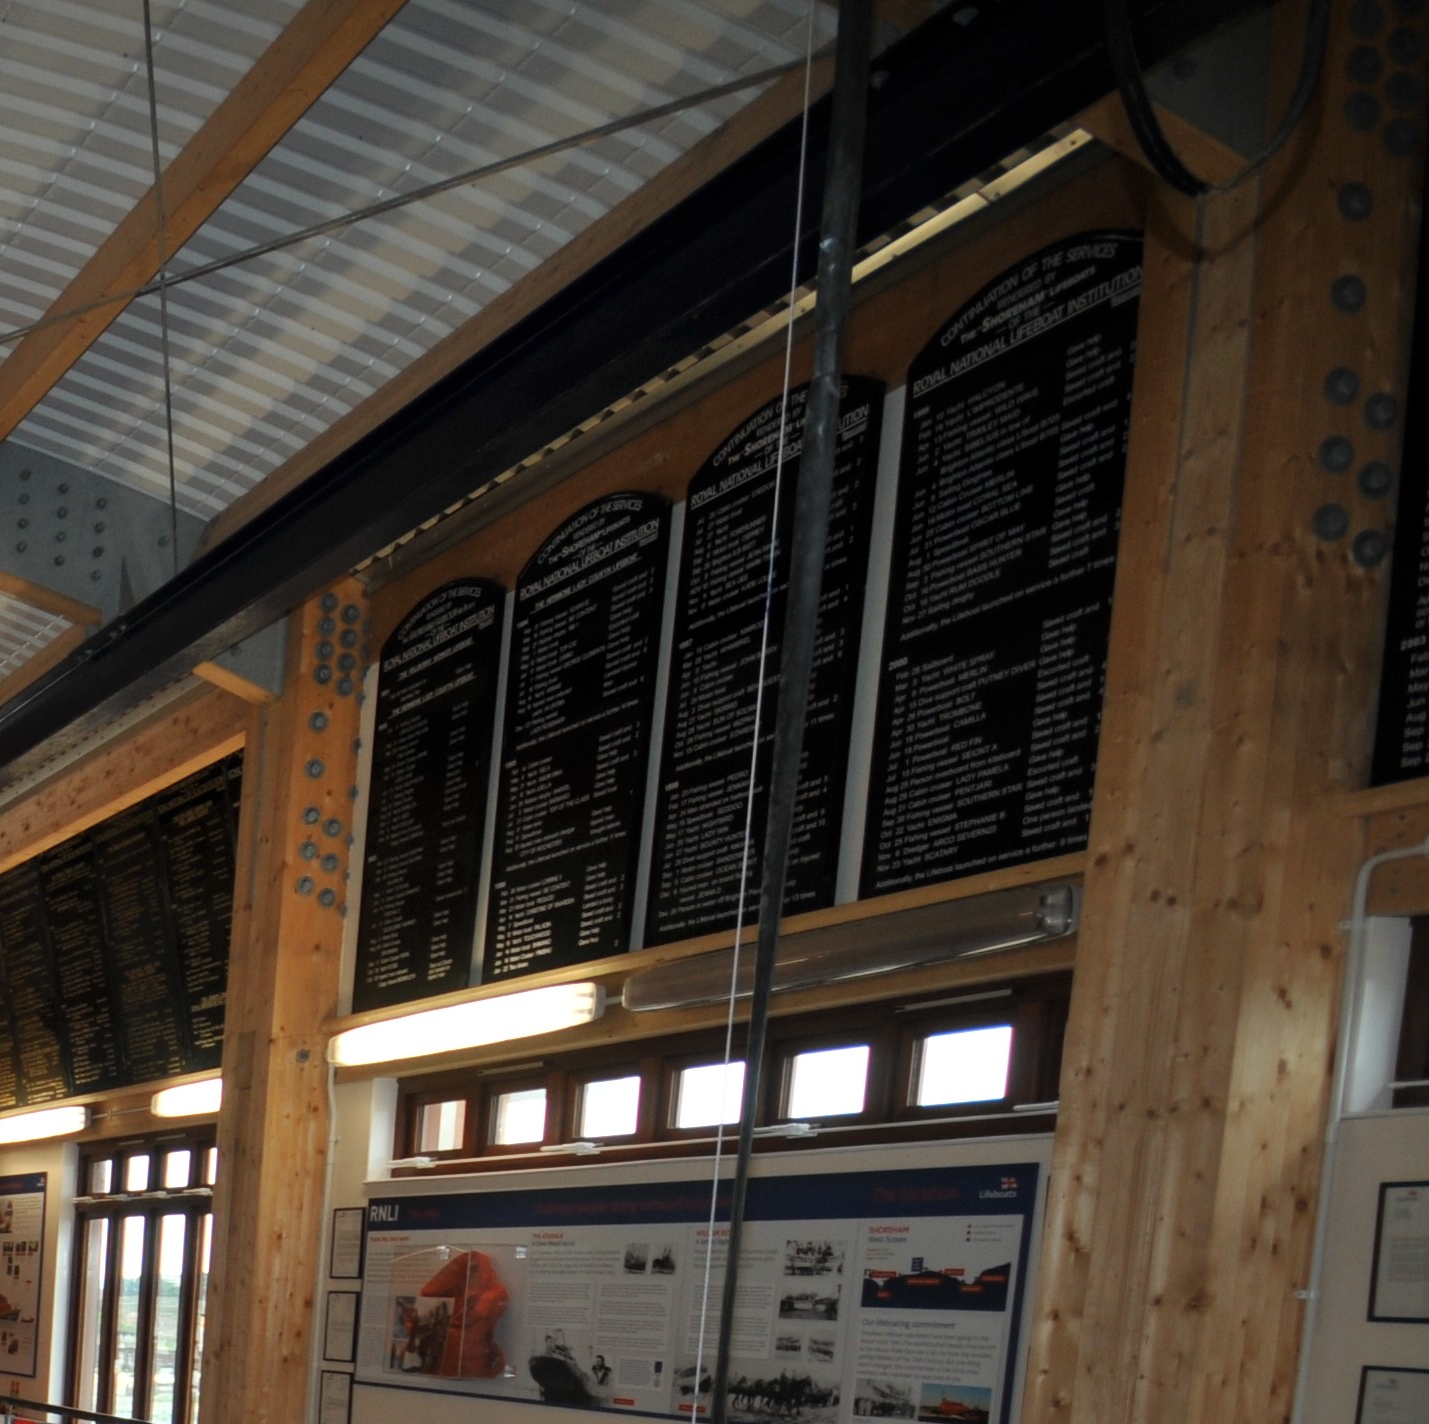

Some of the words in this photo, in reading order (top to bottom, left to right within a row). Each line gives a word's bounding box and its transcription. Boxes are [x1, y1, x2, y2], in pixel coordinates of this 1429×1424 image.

[940, 272, 1018, 347] CONTINUATION
[1022, 260, 1038, 281] OF
[1041, 249, 1062, 272] THE
[1066, 242, 1118, 263] SERVICES
[912, 369, 946, 395] ROYAL
[949, 340, 1008, 377] NATIONAL
[1010, 304, 1065, 344] LIFEBOAT
[369, 1205, 399, 1222] RNLI
